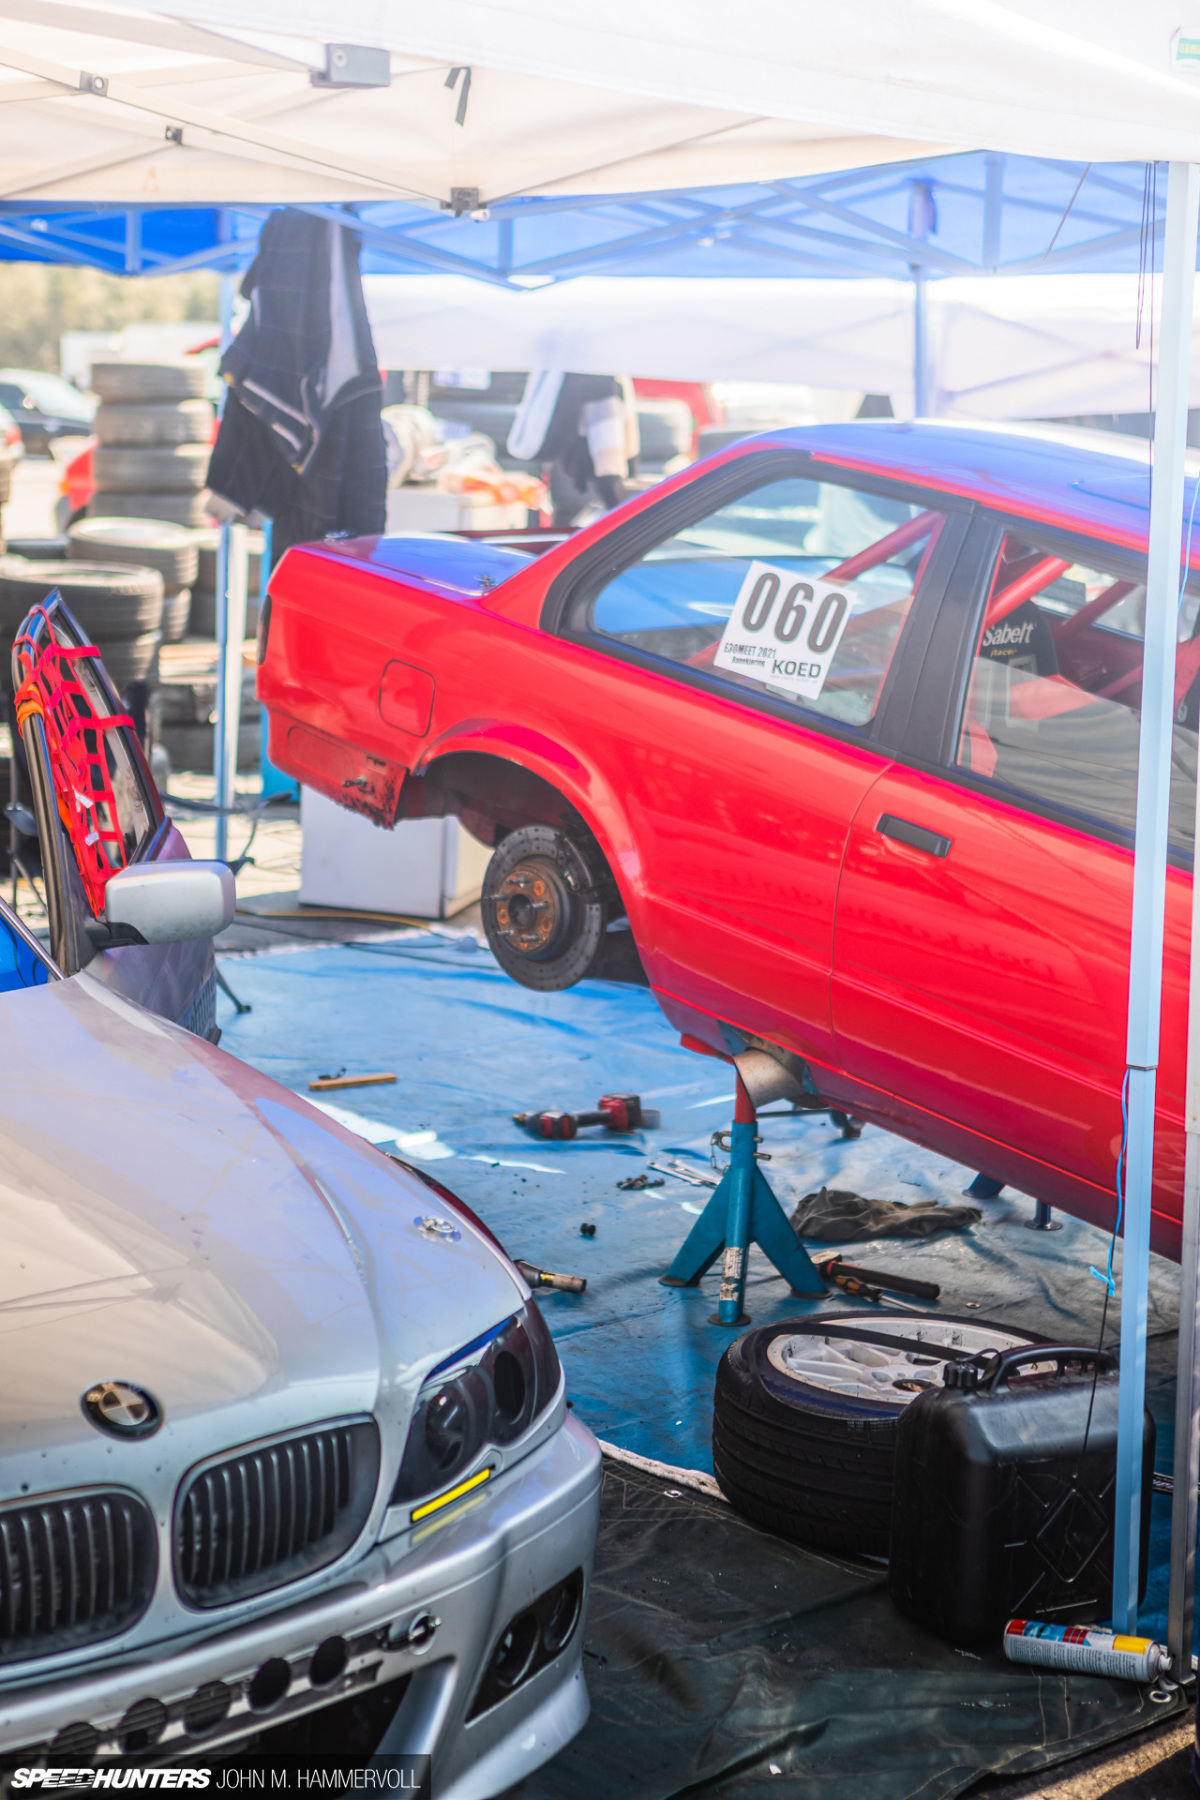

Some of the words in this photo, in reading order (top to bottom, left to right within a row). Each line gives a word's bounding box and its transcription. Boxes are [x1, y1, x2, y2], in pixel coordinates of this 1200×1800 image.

[742, 572, 848, 655] 060
[983, 622, 1034, 646] Sabelt
[758, 646, 777, 659] 2021
[771, 659, 821, 678] KOED
